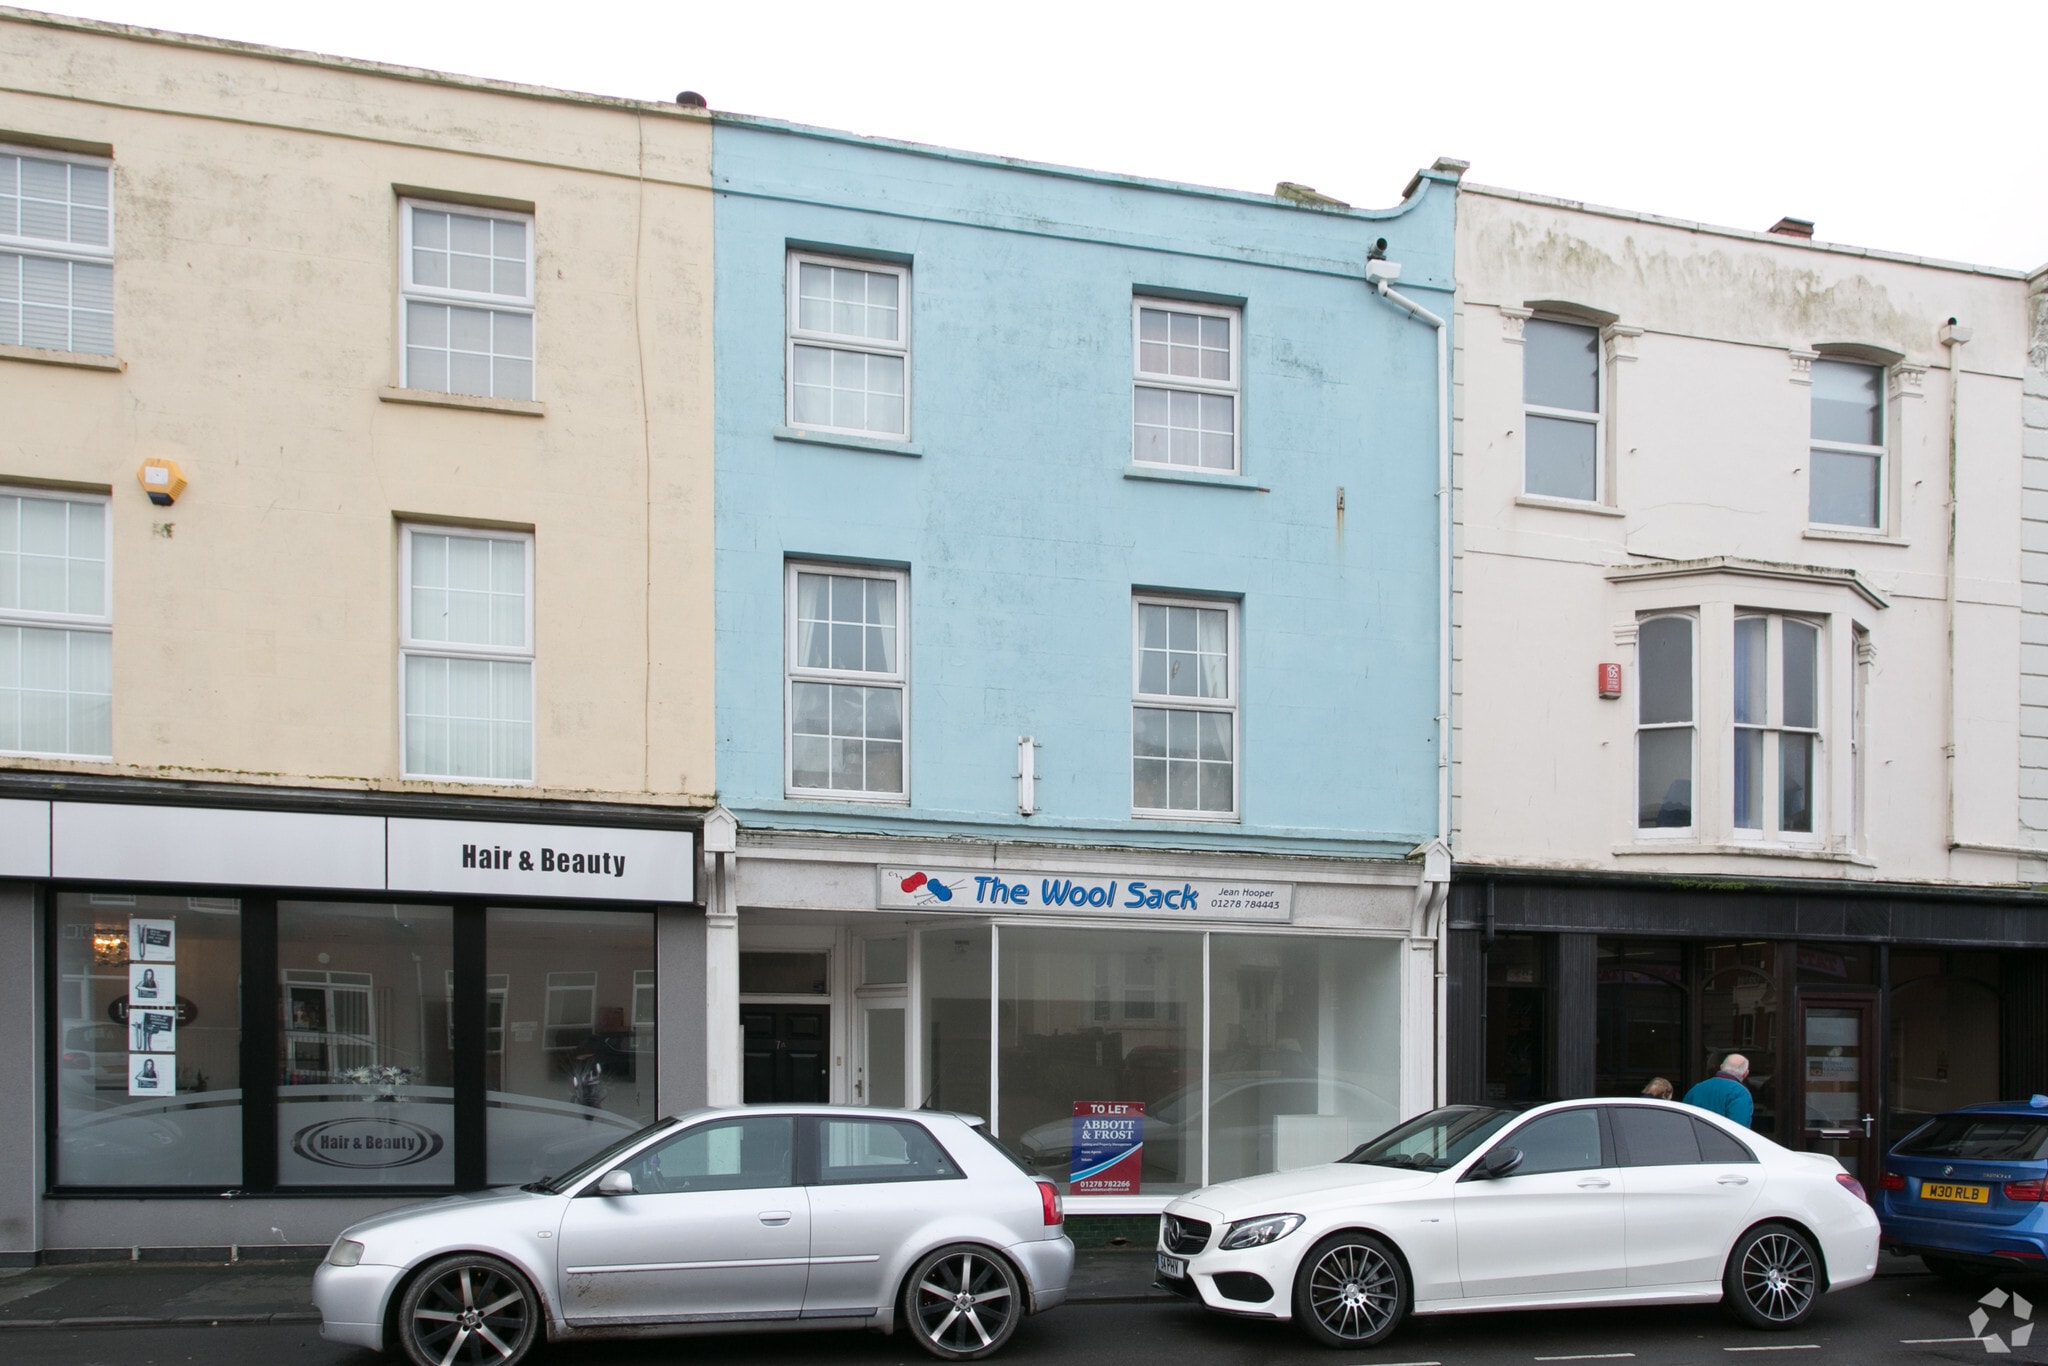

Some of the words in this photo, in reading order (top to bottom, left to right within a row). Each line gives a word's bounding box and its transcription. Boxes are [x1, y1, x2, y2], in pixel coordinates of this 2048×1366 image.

[462, 844, 512, 870] Hair
[518, 850, 534, 871] &
[541, 848, 626, 877] Beauty
[974, 876, 1029, 905] The
[1041, 878, 1117, 907] Wool
[1124, 881, 1199, 910] Sack
[1218, 887, 1240, 897] Jean
[1242, 888, 1275, 898] Hooper
[1210, 899, 1241, 908] 01278
[1244, 900, 1280, 910] 784443
[1090, 1104, 1105, 1114] TO
[1108, 1105, 1128, 1114] LET
[1082, 1120, 1135, 1130] ABBOTT
[1082, 1130, 1091, 1140] &
[1094, 1130, 1134, 1140] FROST
[320, 1135, 350, 1150] Hair
[353, 1138, 362, 1150] &
[366, 1135, 415, 1151] Beauty
[1080, 1180, 1103, 1188] 01278
[1104, 1180, 1130, 1188] 782266
[1929, 1185, 1952, 1199] M30
[1954, 1187, 1980, 1200] RLB
